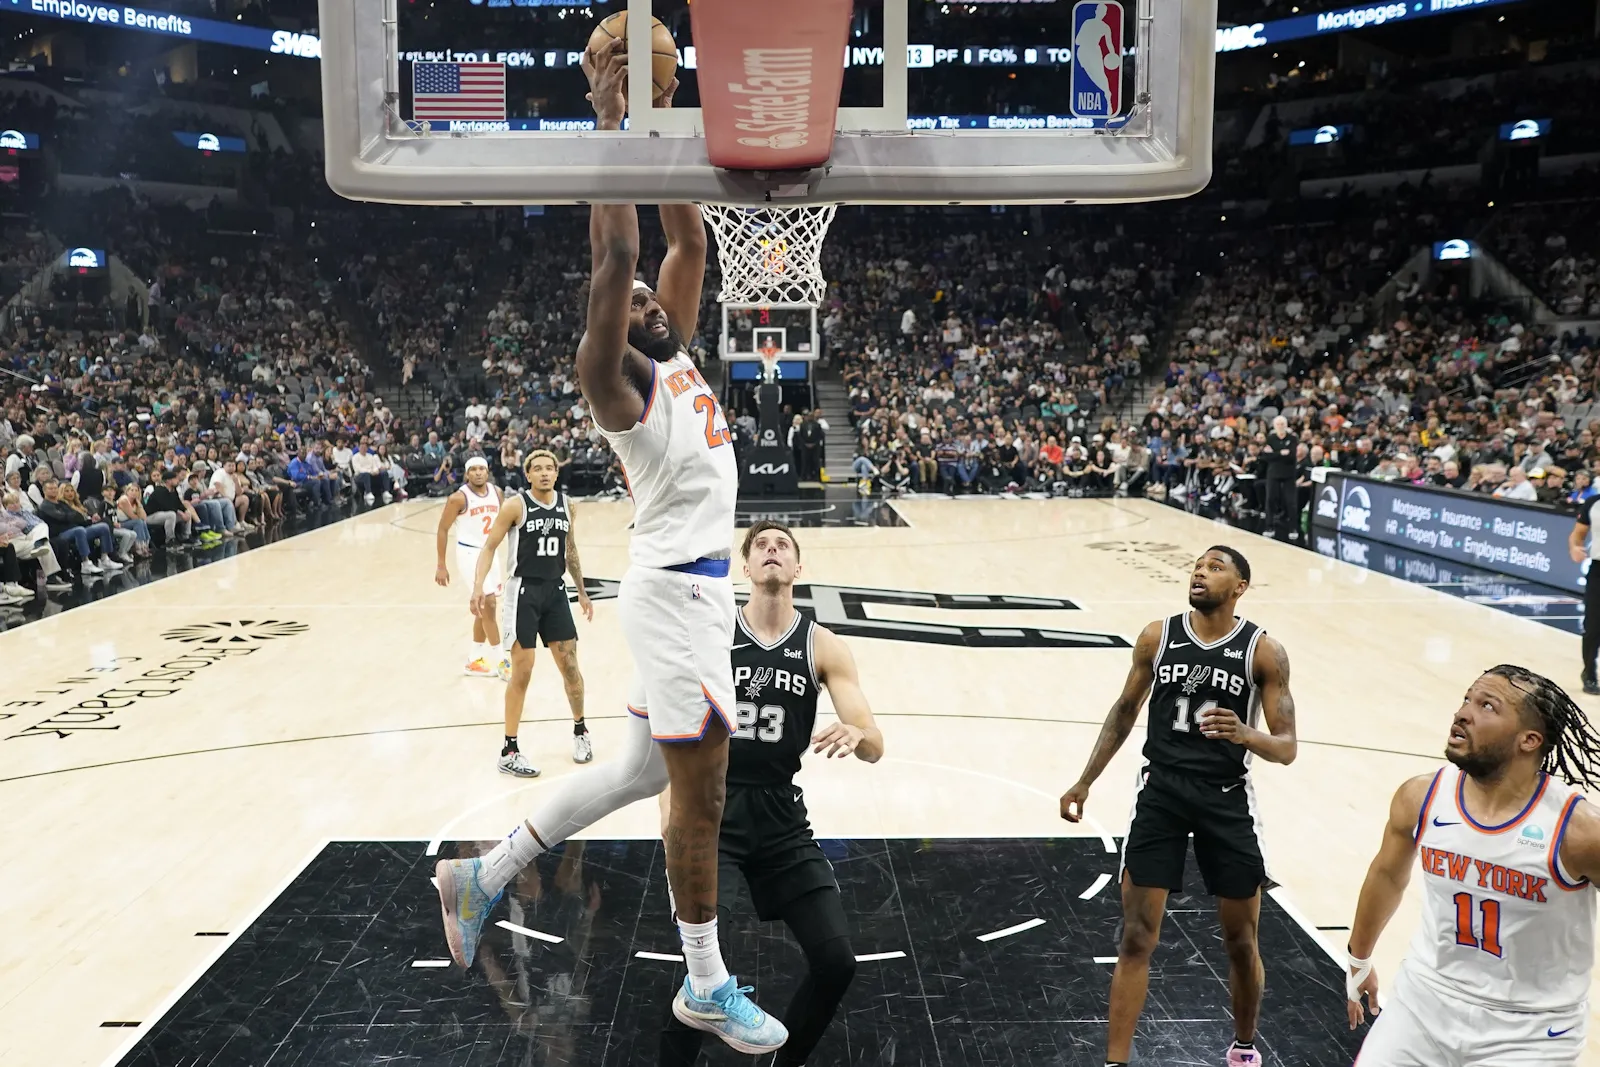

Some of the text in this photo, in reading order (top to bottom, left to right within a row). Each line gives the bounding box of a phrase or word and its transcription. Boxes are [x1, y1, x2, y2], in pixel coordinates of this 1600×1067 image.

[31, 0, 192, 35] Employee Benefits
[1317, 2, 1407, 31] Mortgages
[270, 31, 321, 58] SWB
[1215, 23, 1266, 52] WBC
[935, 48, 959, 63] PF
[978, 48, 1018, 63] FG%
[1046, 48, 1071, 62] TO
[1077, 92, 1102, 111] NBA
[449, 119, 595, 132] Mortgages Insurance
[939, 116, 960, 128] Tax
[988, 116, 1045, 129] Employee
[1046, 115, 1094, 128] Benefits
[749, 463, 789, 474] KIA
[526, 518, 569, 534] SPURS
[1392, 498, 1548, 544] Mortgages Insurance Real Estate
[537, 536, 559, 556] 10
[1385, 519, 1551, 573] HR Property Tax Employee Benefits
[783, 647, 803, 660] Self.
[1223, 648, 1243, 660] Self.
[735, 666, 807, 698] PURS
[1159, 663, 1245, 696] SPURS
[736, 701, 786, 743] 23
[1516, 837, 1545, 850] sphere
[1420, 844, 1549, 903] NEW YORK
[1453, 890, 1503, 959] 11
